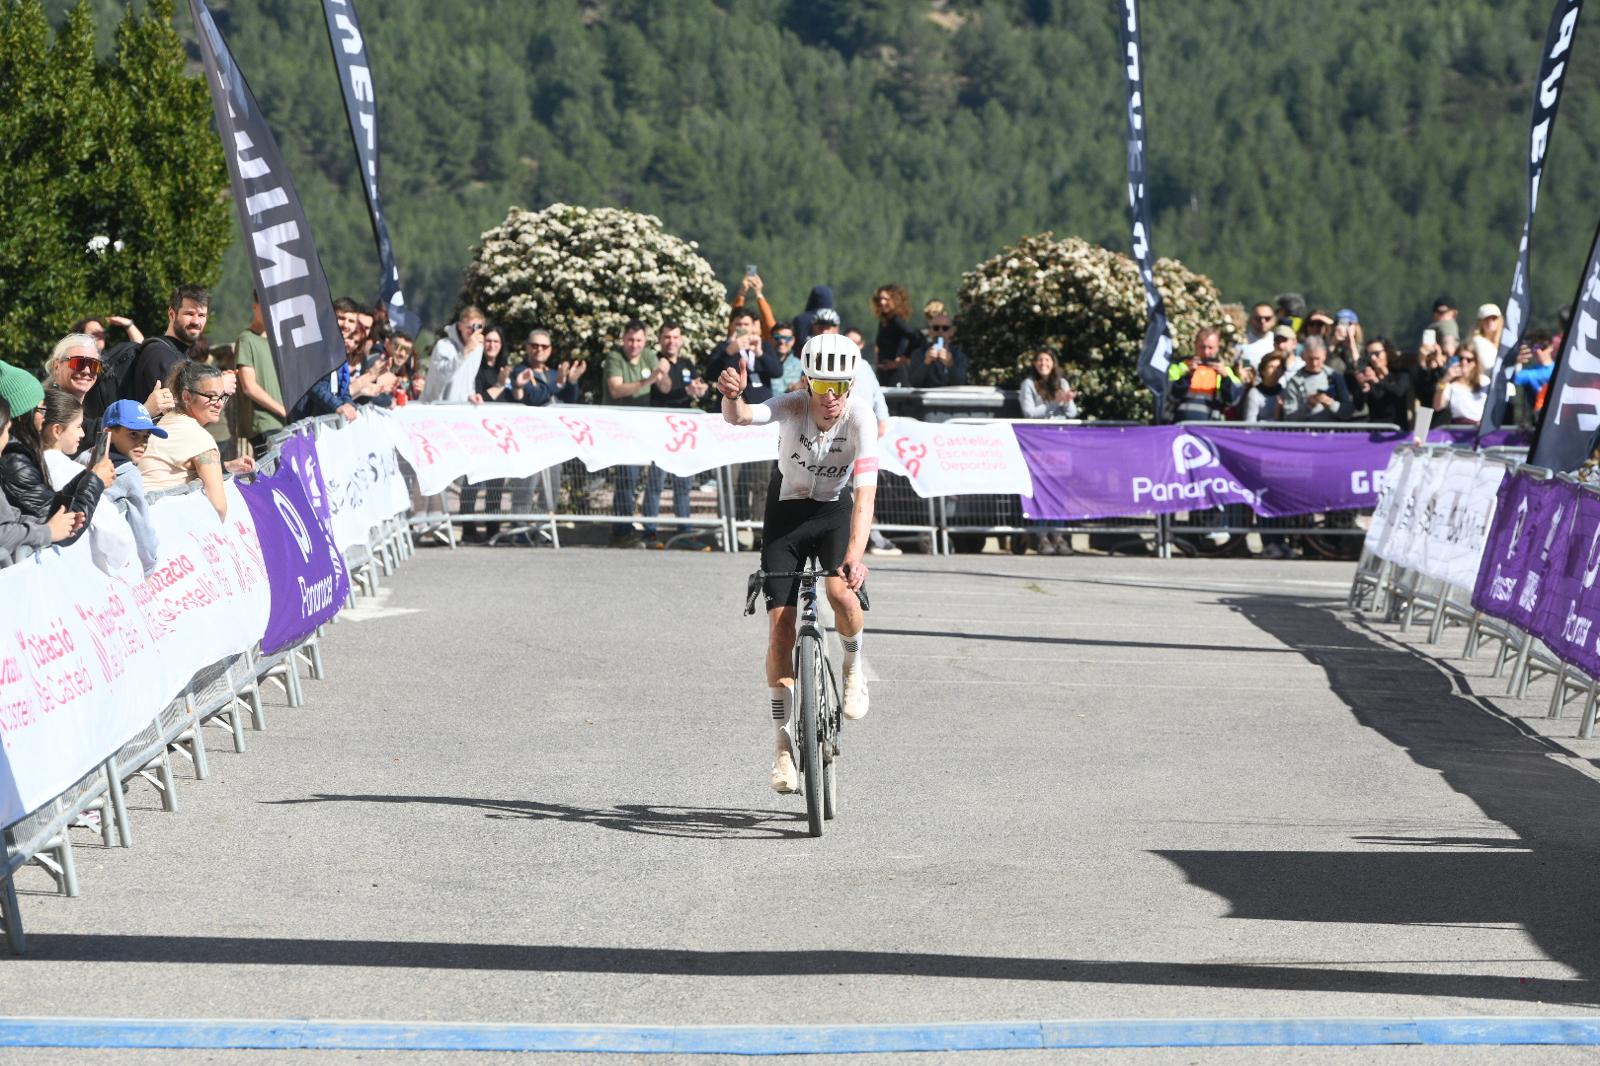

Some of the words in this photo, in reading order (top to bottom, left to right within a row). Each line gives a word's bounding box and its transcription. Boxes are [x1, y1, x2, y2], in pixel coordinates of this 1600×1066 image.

[800, 434, 812, 451] RCC
[791, 452, 849, 475] FACTOR
[800, 591, 817, 612] 2
